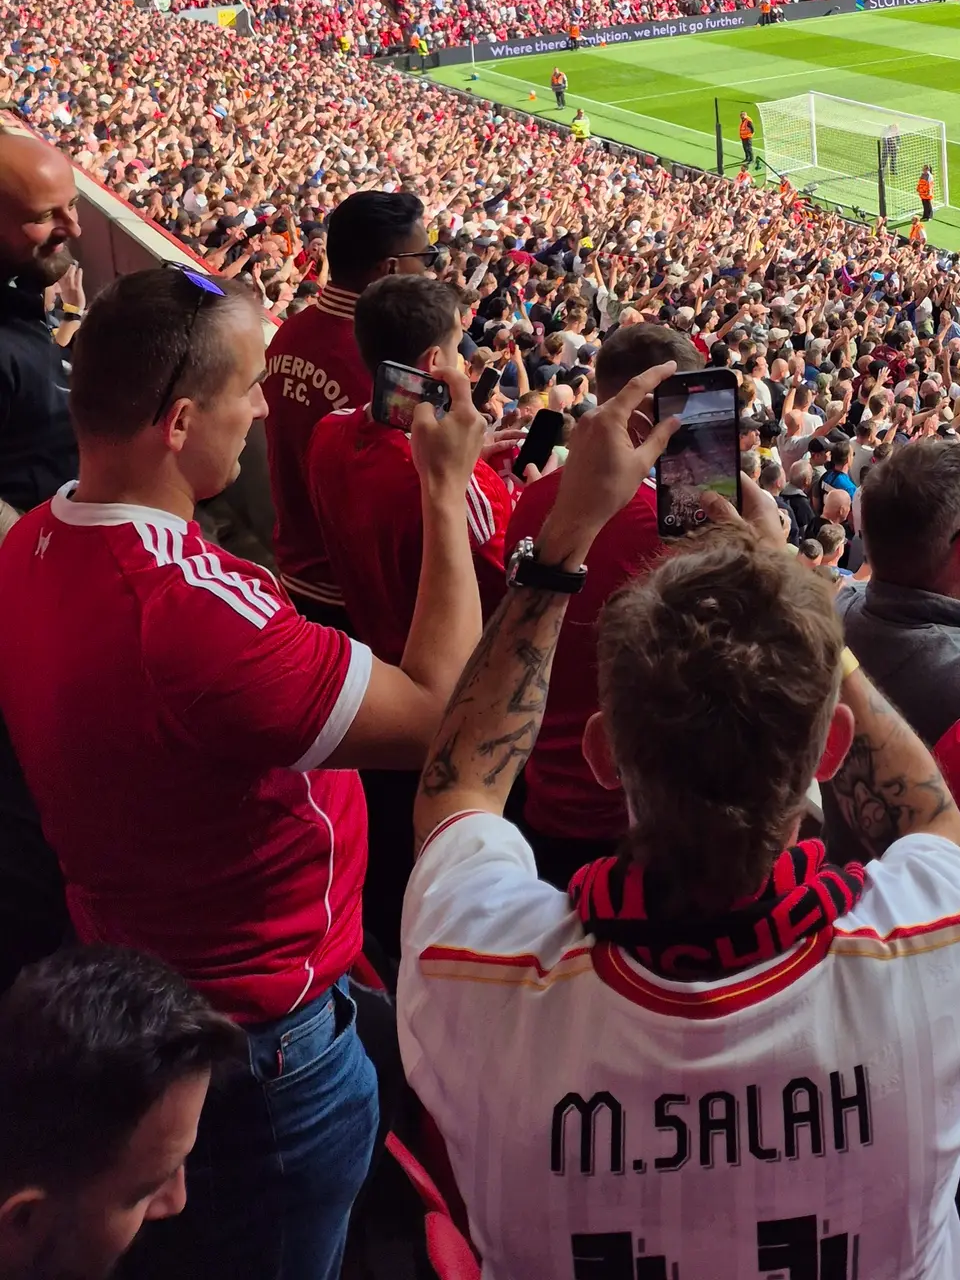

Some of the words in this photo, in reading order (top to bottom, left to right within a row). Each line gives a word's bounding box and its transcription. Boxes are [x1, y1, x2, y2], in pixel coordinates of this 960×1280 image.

[490, 43, 532, 58] Where
[580, 31, 632, 46] mbition,
[634, 28, 650, 38] we
[653, 22, 677, 37] help
[679, 21, 687, 32] it
[689, 21, 703, 34] go
[705, 16, 745, 30] further.
[283, 377, 310, 407] F.C.
[550, 1064, 873, 1176] M.SALAH
